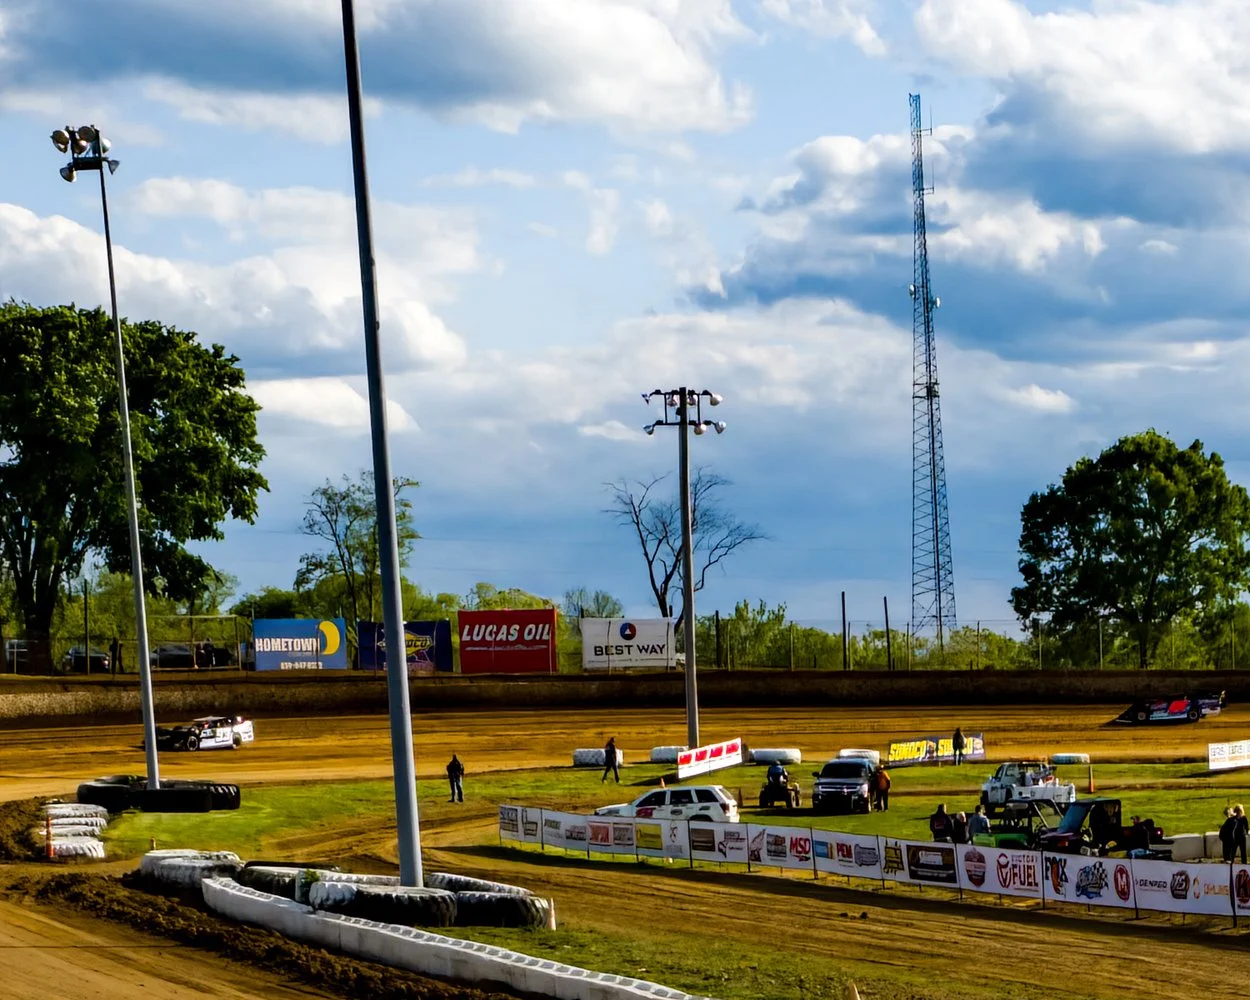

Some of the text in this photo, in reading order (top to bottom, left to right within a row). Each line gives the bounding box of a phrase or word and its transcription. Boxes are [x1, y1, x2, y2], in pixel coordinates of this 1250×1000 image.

[462, 624, 550, 642] LUCAS OIL
[255, 638, 320, 652] HOMETOWN
[594, 644, 665, 656] BEST WAY
[889, 740, 927, 761] SUNOCO
[1012, 864, 1039, 887] FUEL
